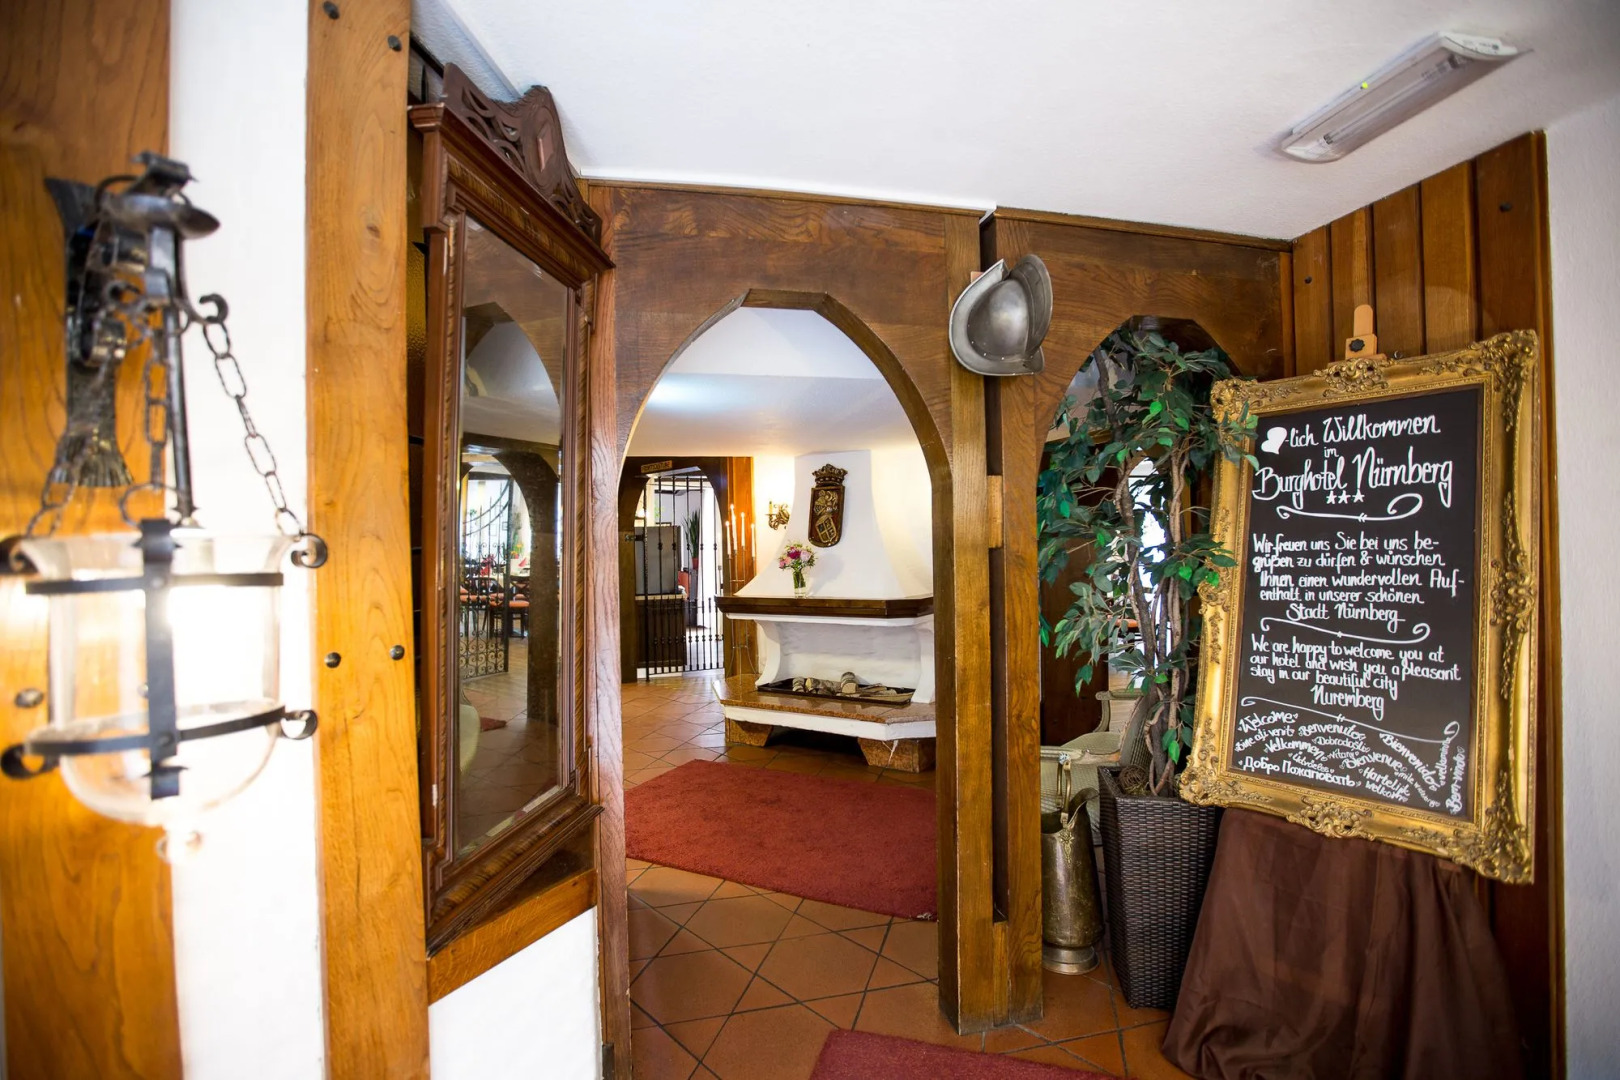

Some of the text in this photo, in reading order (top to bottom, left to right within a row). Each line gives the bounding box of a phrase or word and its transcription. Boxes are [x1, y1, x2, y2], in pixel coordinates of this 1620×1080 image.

[1323, 414, 1441, 443] Willkommen
[1324, 447, 1339, 458] im
[1252, 446, 1453, 509] Burghotel Nürnberg
[1253, 530, 1439, 556] Wir freuen uns Sie bei uns be-
[1252, 550, 1445, 574] grüßen zu dürfen & wünschen
[1260, 568, 1465, 598] Ihnen einen wundervollen Auf-
[1260, 587, 1425, 604] enthalt in unserer schönen
[1286, 602, 1406, 633] Stadt Nürnberg
[1251, 633, 1444, 667] We are happy to welcome you at
[1250, 652, 1461, 681] our hotel and wish you a pleasant
[1250, 665, 1398, 700] stay in our beautiful city
[1310, 685, 1384, 720] Nuremberg
[1240, 710, 1295, 733] Welcome
[1243, 756, 1280, 775] Добро
